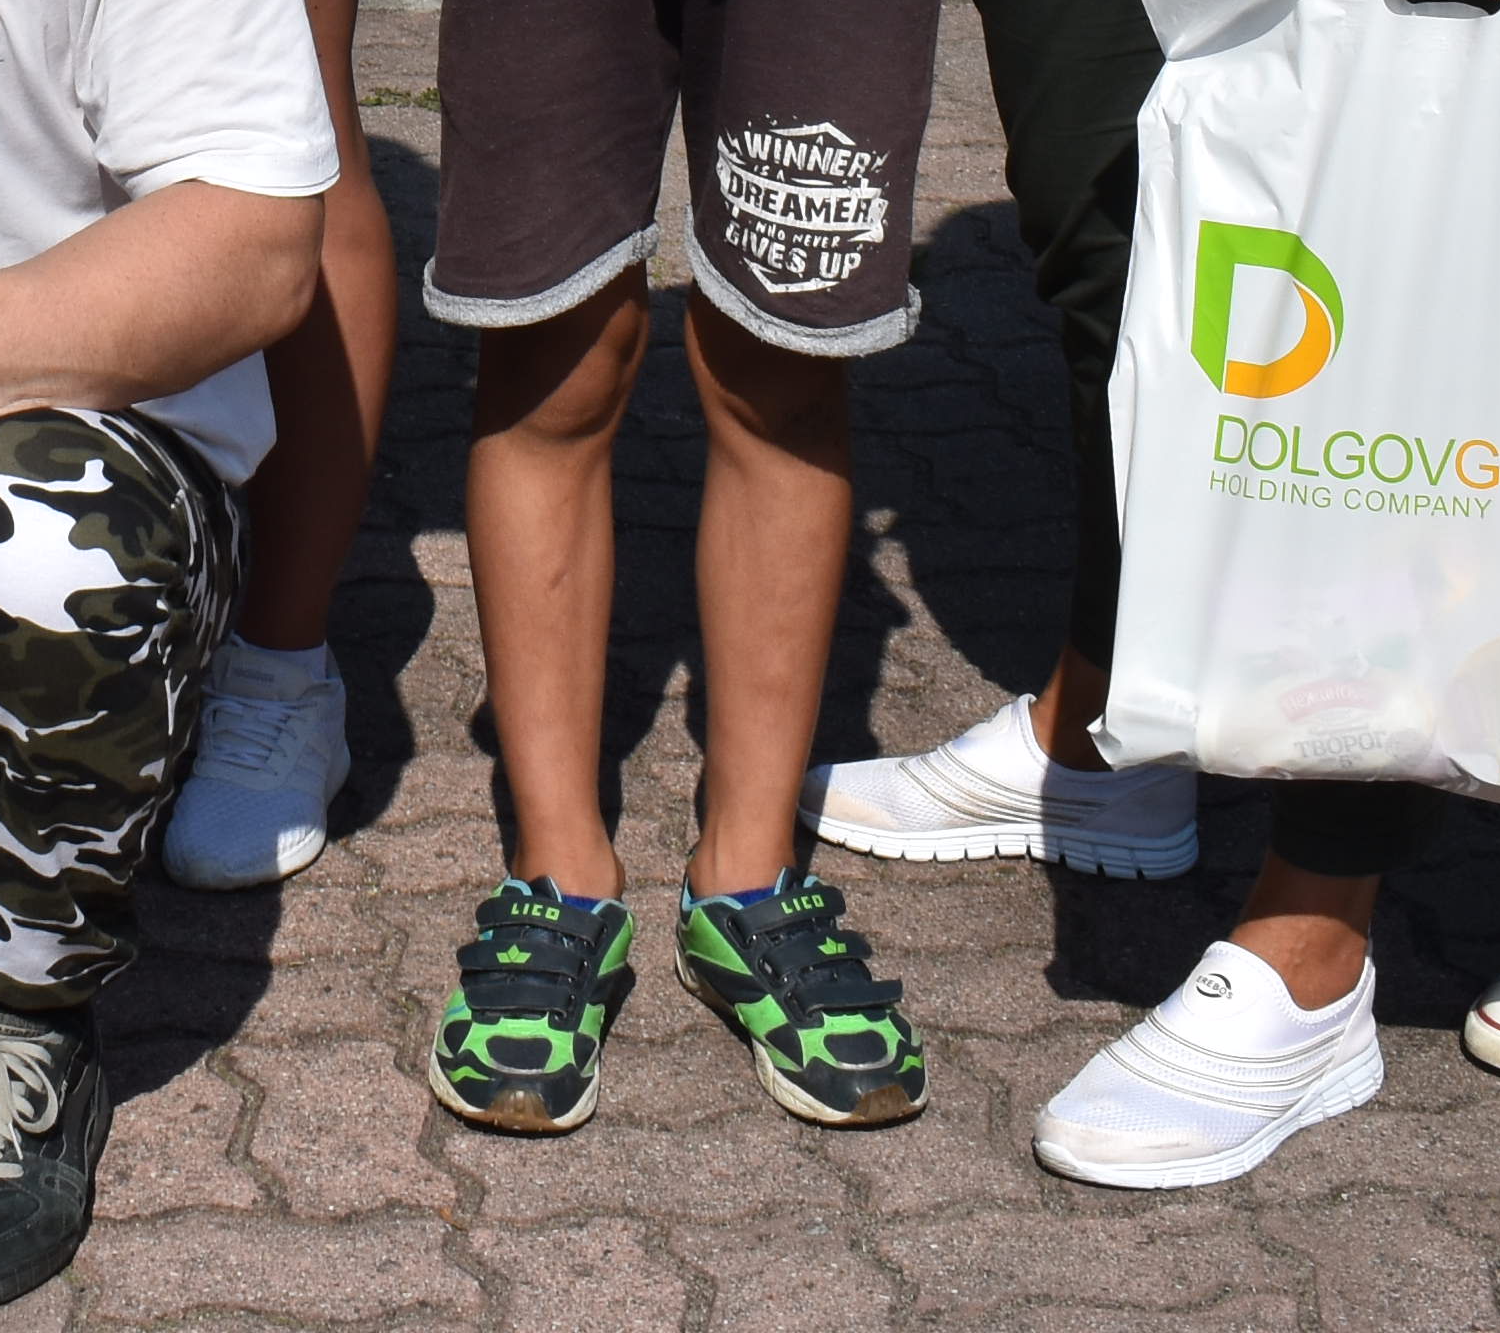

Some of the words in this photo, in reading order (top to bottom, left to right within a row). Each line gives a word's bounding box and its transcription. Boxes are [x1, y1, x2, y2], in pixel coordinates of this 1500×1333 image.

[816, 135, 824, 146] A
[744, 131, 870, 179] WINNER
[754, 165, 769, 176] IS
[777, 169, 785, 181] A
[728, 171, 871, 224] DREAMER
[756, 221, 786, 241] WHO
[792, 233, 841, 249] NEVER
[725, 221, 806, 275] GIVES
[819, 251, 862, 279] UP
[1210, 470, 1332, 509] HOLDING
[1344, 488, 1493, 519] COMPANY
[1294, 733, 1387, 758] ТВОРОГ
[511, 902, 560, 921] LICO
[781, 894, 824, 915] LICO
